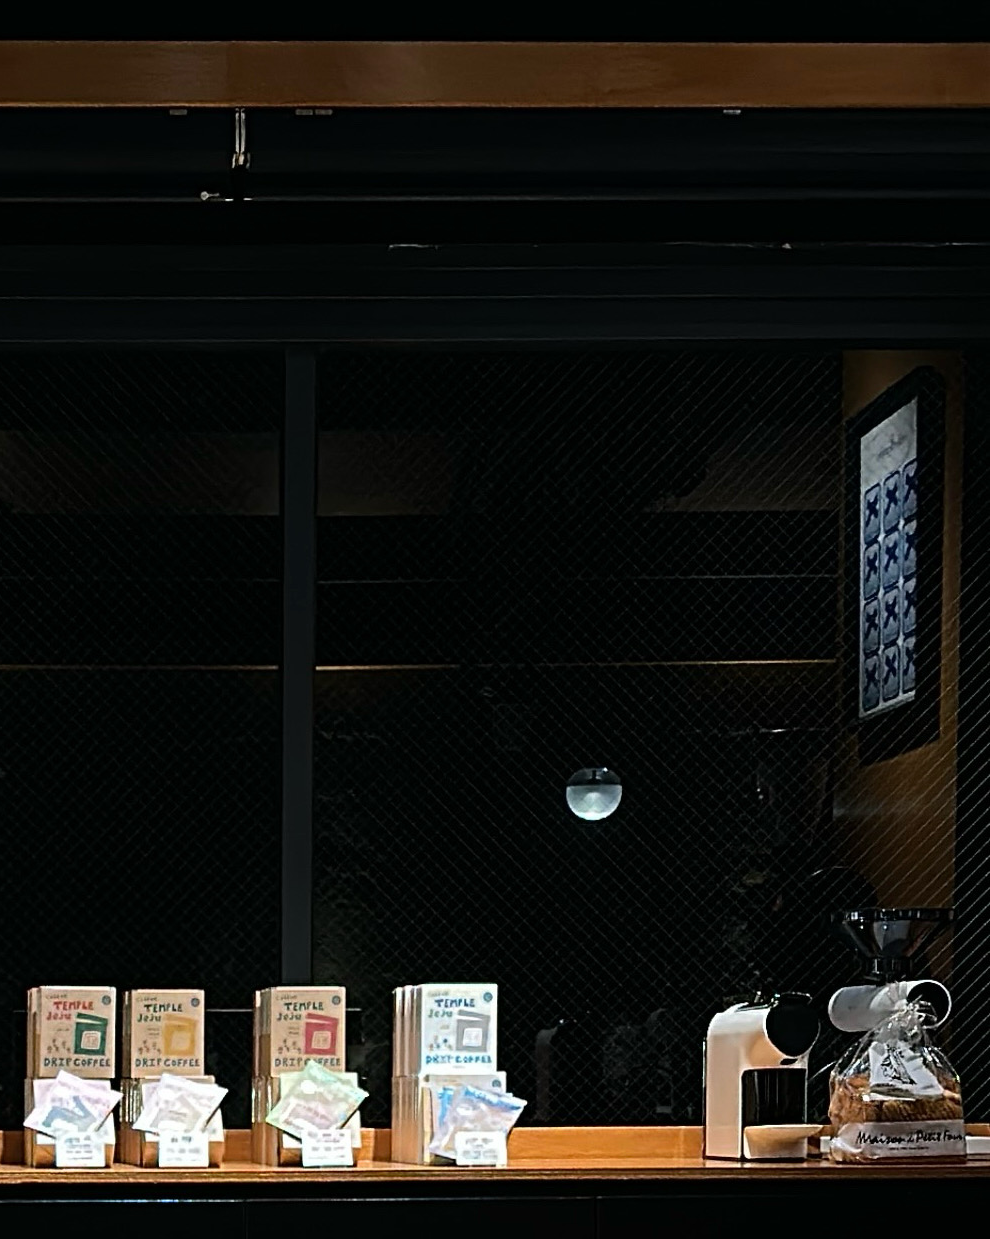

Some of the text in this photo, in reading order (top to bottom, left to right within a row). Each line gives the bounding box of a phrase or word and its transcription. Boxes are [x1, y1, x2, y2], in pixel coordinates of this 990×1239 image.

[52, 1001, 94, 1010] TEMPLE
[143, 1003, 183, 1013] TEMPLE
[283, 1001, 324, 1011] TEMPLE
[434, 998, 475, 1008] TEMPLE
[43, 1057, 111, 1067] DRIP COFFEE
[135, 1058, 200, 1068] DRIP COFFEE
[274, 1058, 303, 1067] DRIP
[455, 1055, 492, 1064] COFFEE
[856, 1130, 905, 1145] Maison
